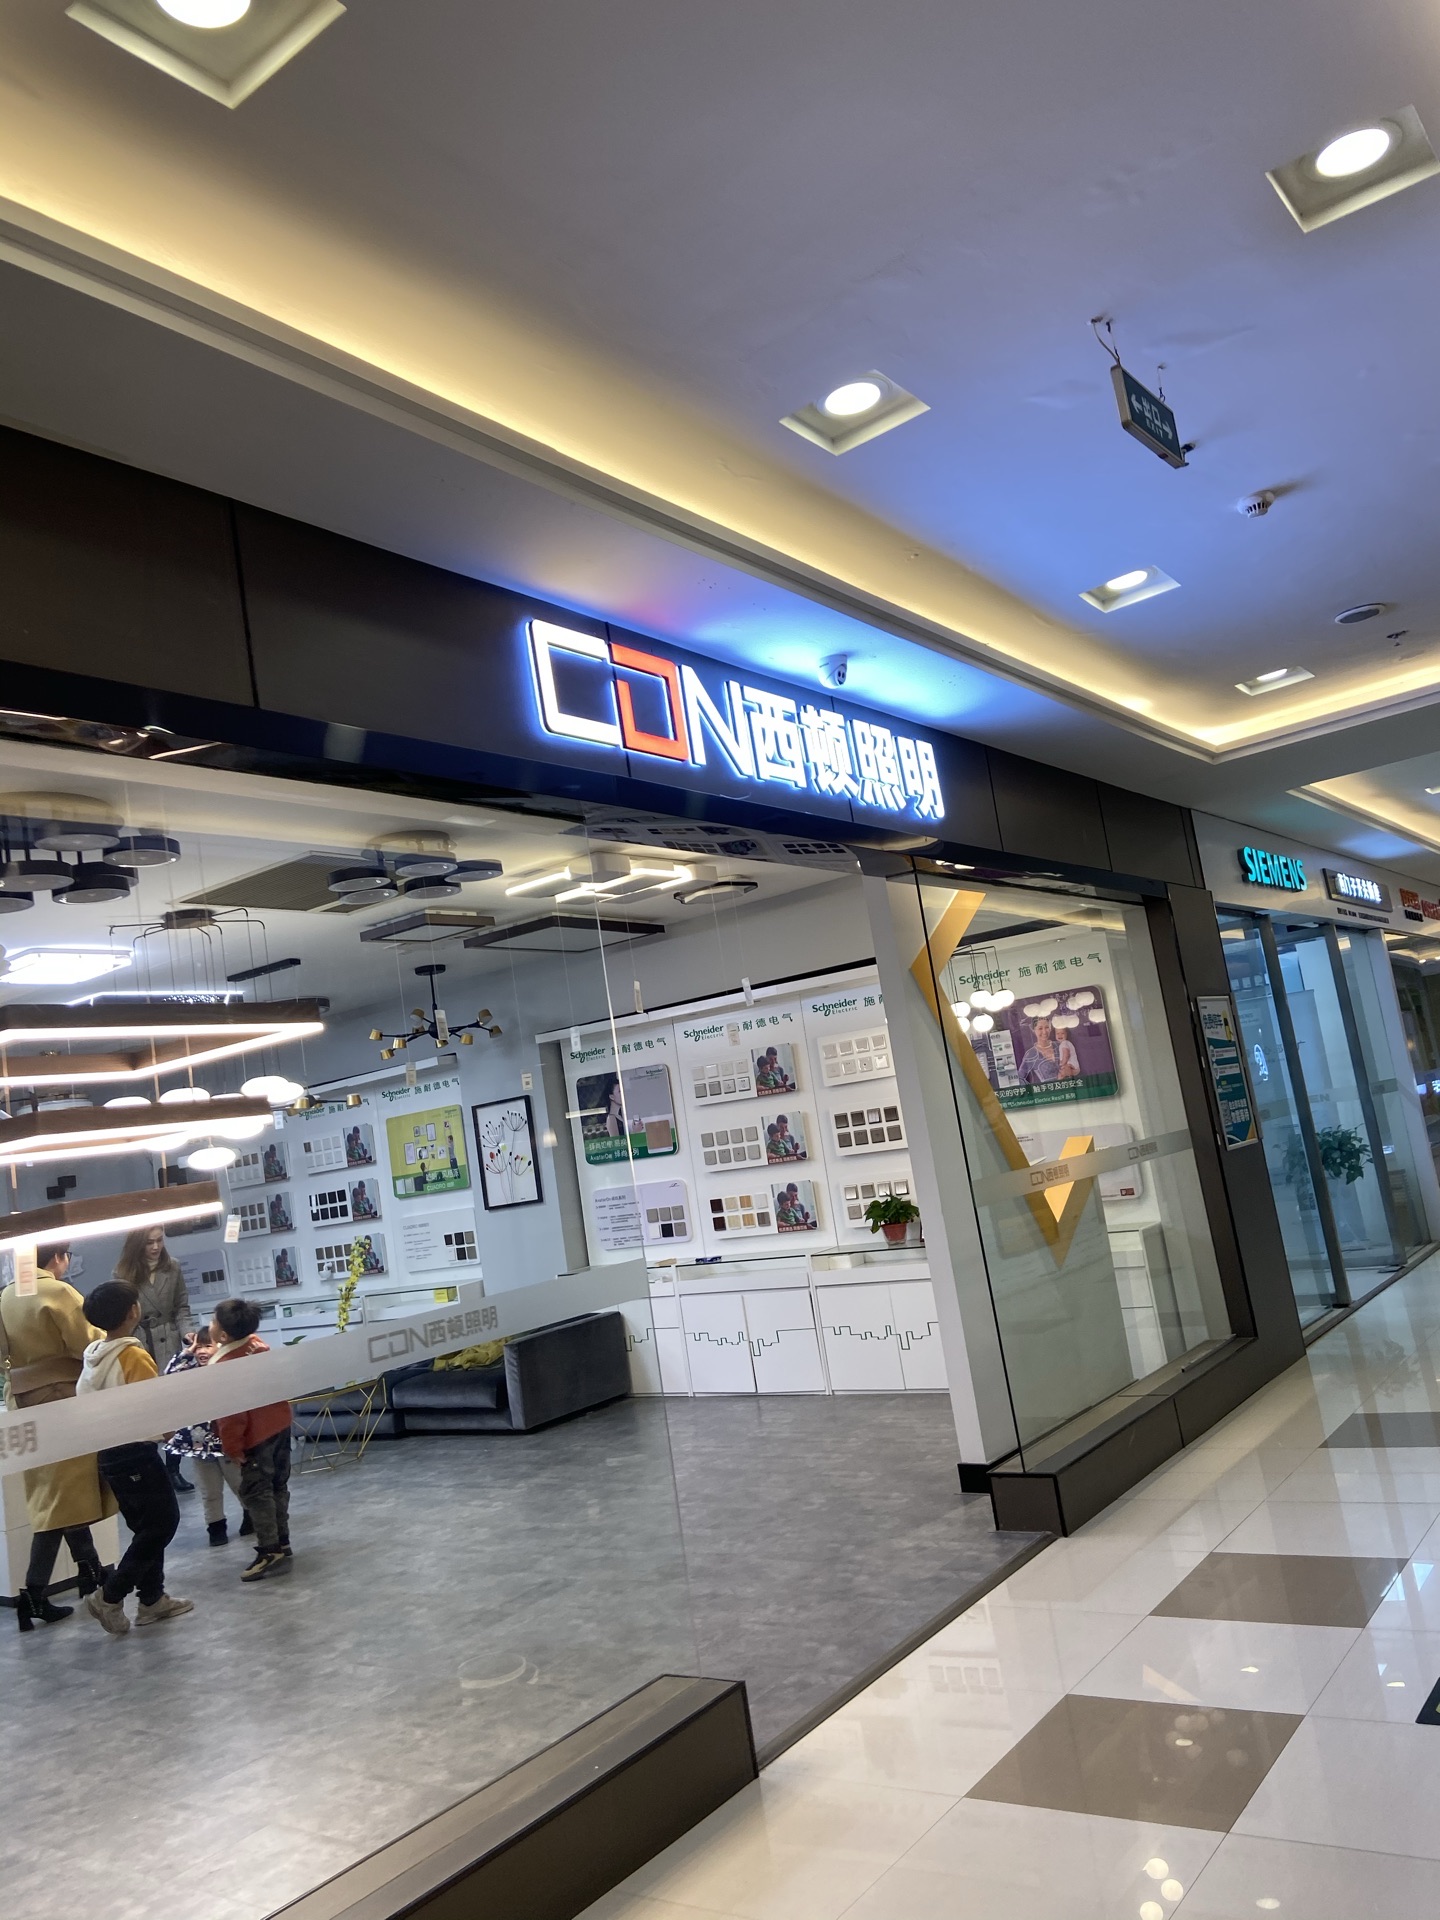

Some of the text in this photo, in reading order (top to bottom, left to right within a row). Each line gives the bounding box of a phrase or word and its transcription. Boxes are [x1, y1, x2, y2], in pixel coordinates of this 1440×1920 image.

[1242, 846, 1308, 891] SIEMENS
[957, 952, 1102, 989] Schneider 施耐德电气
[812, 998, 858, 1016] Schneider
[832, 1006, 858, 1014] Electric
[683, 1025, 724, 1042] Schneider
[736, 1012, 793, 1033] 耐德电气
[569, 1047, 606, 1063] Schneider
[381, 1077, 460, 1102] Schneider 施耐德电气
